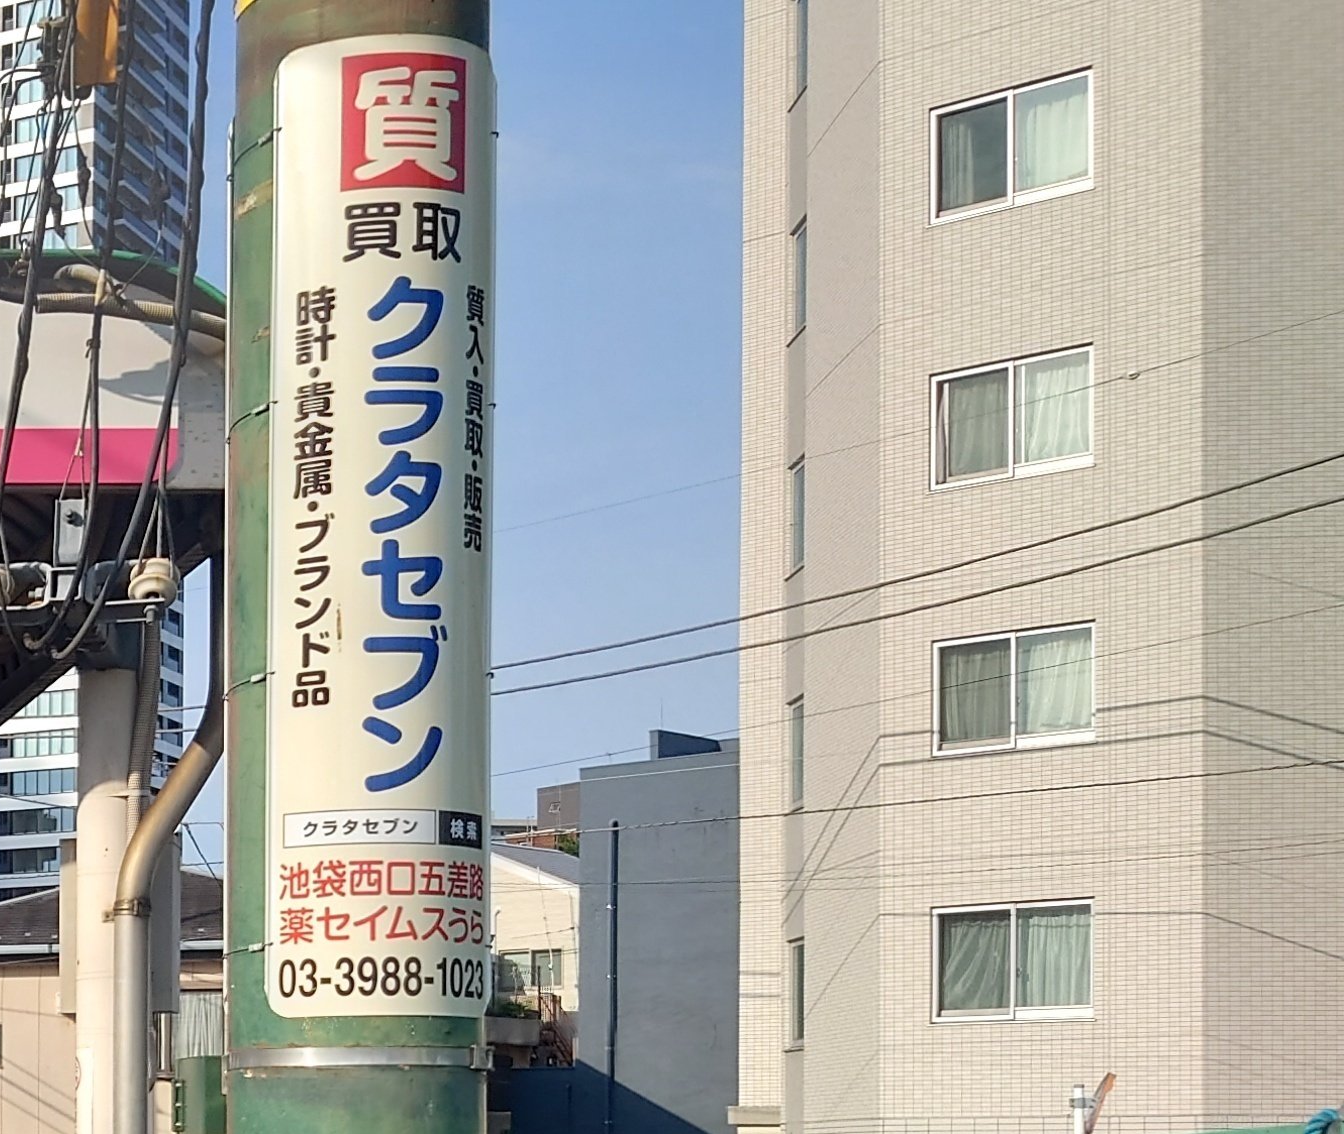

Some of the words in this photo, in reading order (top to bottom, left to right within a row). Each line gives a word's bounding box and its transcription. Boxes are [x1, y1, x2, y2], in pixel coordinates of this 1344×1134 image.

[354, 66, 460, 183] 質
[342, 201, 462, 264] 買取
[462, 285, 486, 552] 質入・買取・販売
[291, 285, 337, 708] 時計・貴金属・ブランド品
[361, 275, 448, 794] クラタセブン
[302, 817, 419, 839] クラタセブン
[449, 816, 479, 841] 検索
[278, 860, 484, 901] 池袋西口五差路
[278, 906, 484, 946] 薬セイムスうら
[278, 956, 484, 1001] 03-3988-1023
